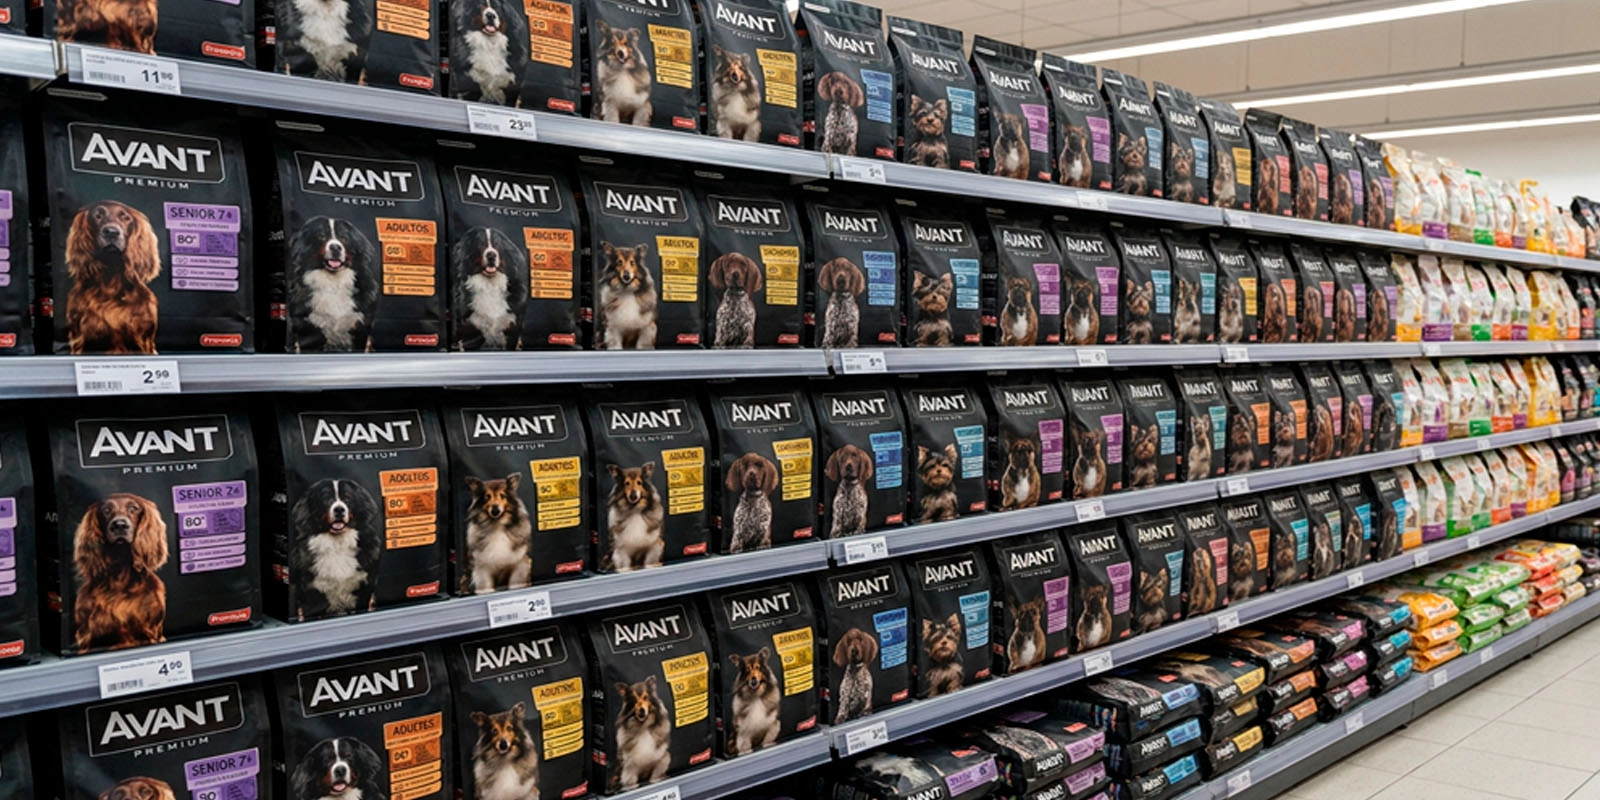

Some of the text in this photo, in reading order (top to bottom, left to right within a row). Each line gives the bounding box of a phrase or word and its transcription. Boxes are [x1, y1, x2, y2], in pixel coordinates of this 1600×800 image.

[716, 2, 776, 33] AVANT
[824, 31, 876, 54] AVANT
[911, 53, 959, 74] AVANT
[81, 132, 211, 172] AVANT
[114, 177, 189, 189] PREMIUM
[308, 160, 412, 193] AVANT
[467, 174, 550, 204] AVANT
[170, 207, 216, 219] SENIOR
[605, 189, 678, 215] AVANT
[717, 202, 782, 226] AVANT
[825, 212, 878, 233] AVANT
[386, 223, 429, 233] ADULTOS
[915, 224, 964, 243] AVANT
[832, 398, 886, 417] AVANT
[919, 394, 967, 412] AVANT
[1005, 390, 1048, 407] AVANT
[611, 408, 682, 430] AVANT
[732, 402, 792, 422] AVANT
[312, 418, 412, 446] AVANT
[473, 414, 556, 438] AVANT
[89, 426, 218, 457] AVANT
[122, 463, 198, 475] PREMIUM
[179, 487, 222, 500] SENIOR
[1010, 547, 1055, 571] AVANT
[924, 560, 974, 585] AVANT
[837, 574, 890, 601] AVANT
[731, 592, 791, 622] AVANT
[614, 614, 681, 645] AVANT
[475, 637, 555, 673] AVANT
[310, 665, 418, 707] AVANT
[101, 696, 229, 745] AVANT
[339, 702, 403, 719] PREMIUM
[134, 737, 209, 758] PREMIUM
[192, 760, 236, 777] SENIOR
